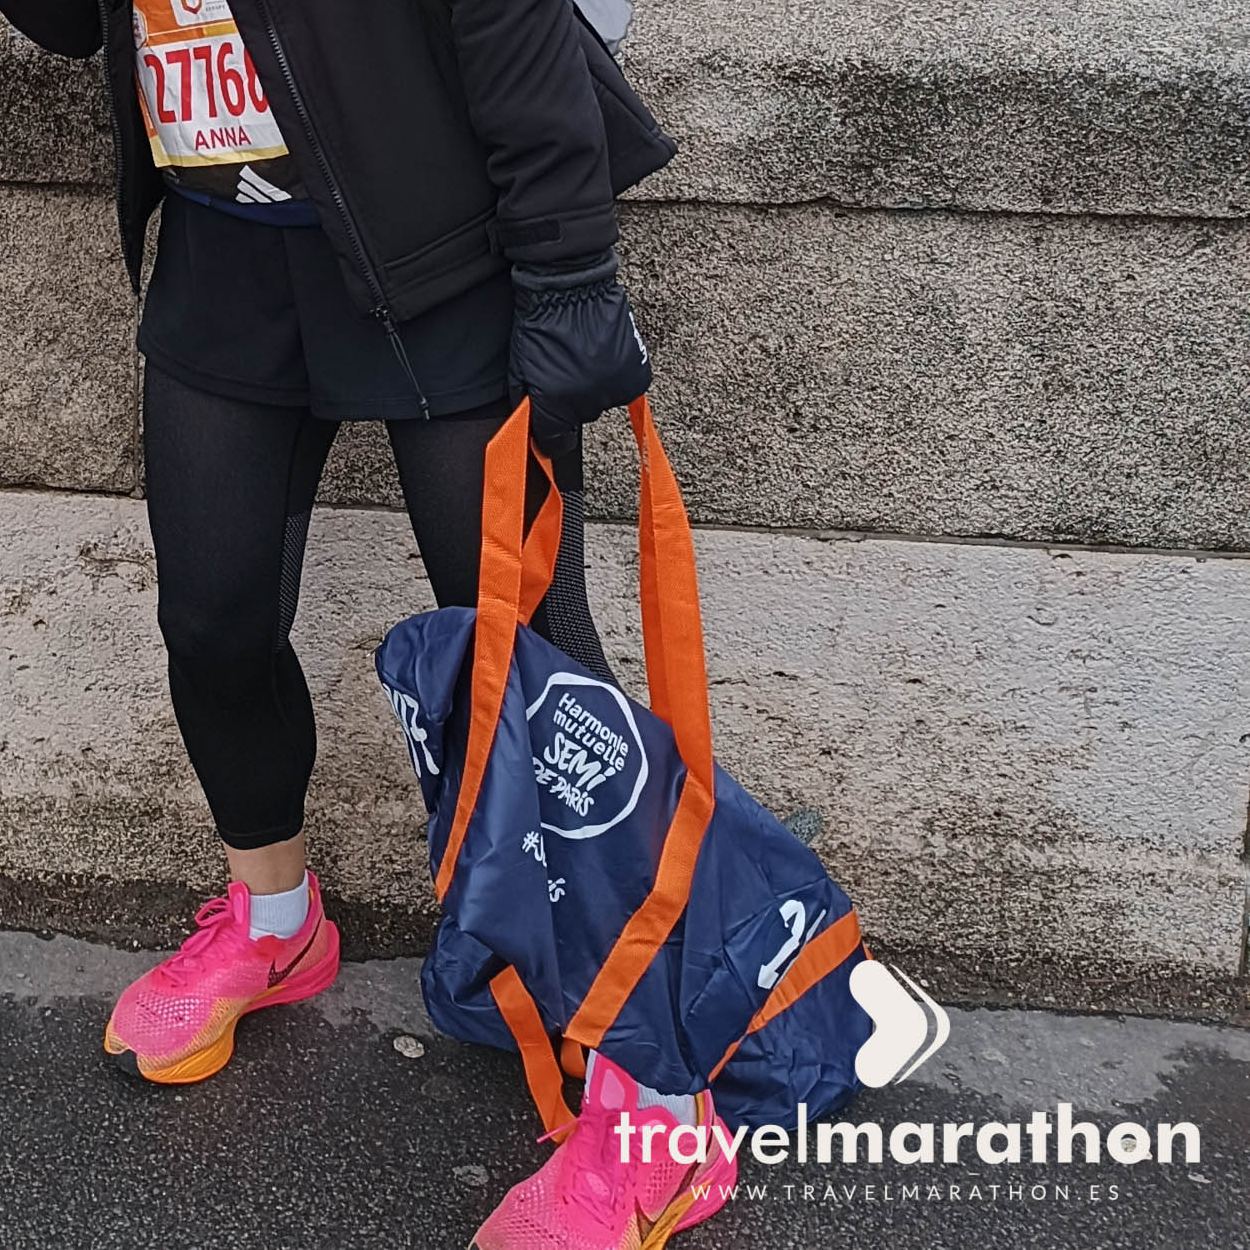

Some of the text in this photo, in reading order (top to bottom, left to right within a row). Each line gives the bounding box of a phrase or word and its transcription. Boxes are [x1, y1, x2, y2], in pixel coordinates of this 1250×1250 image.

[195, 126, 251, 151] ANNA
[553, 710, 625, 771] mutuelle
[558, 693, 628, 756] Harmonie
